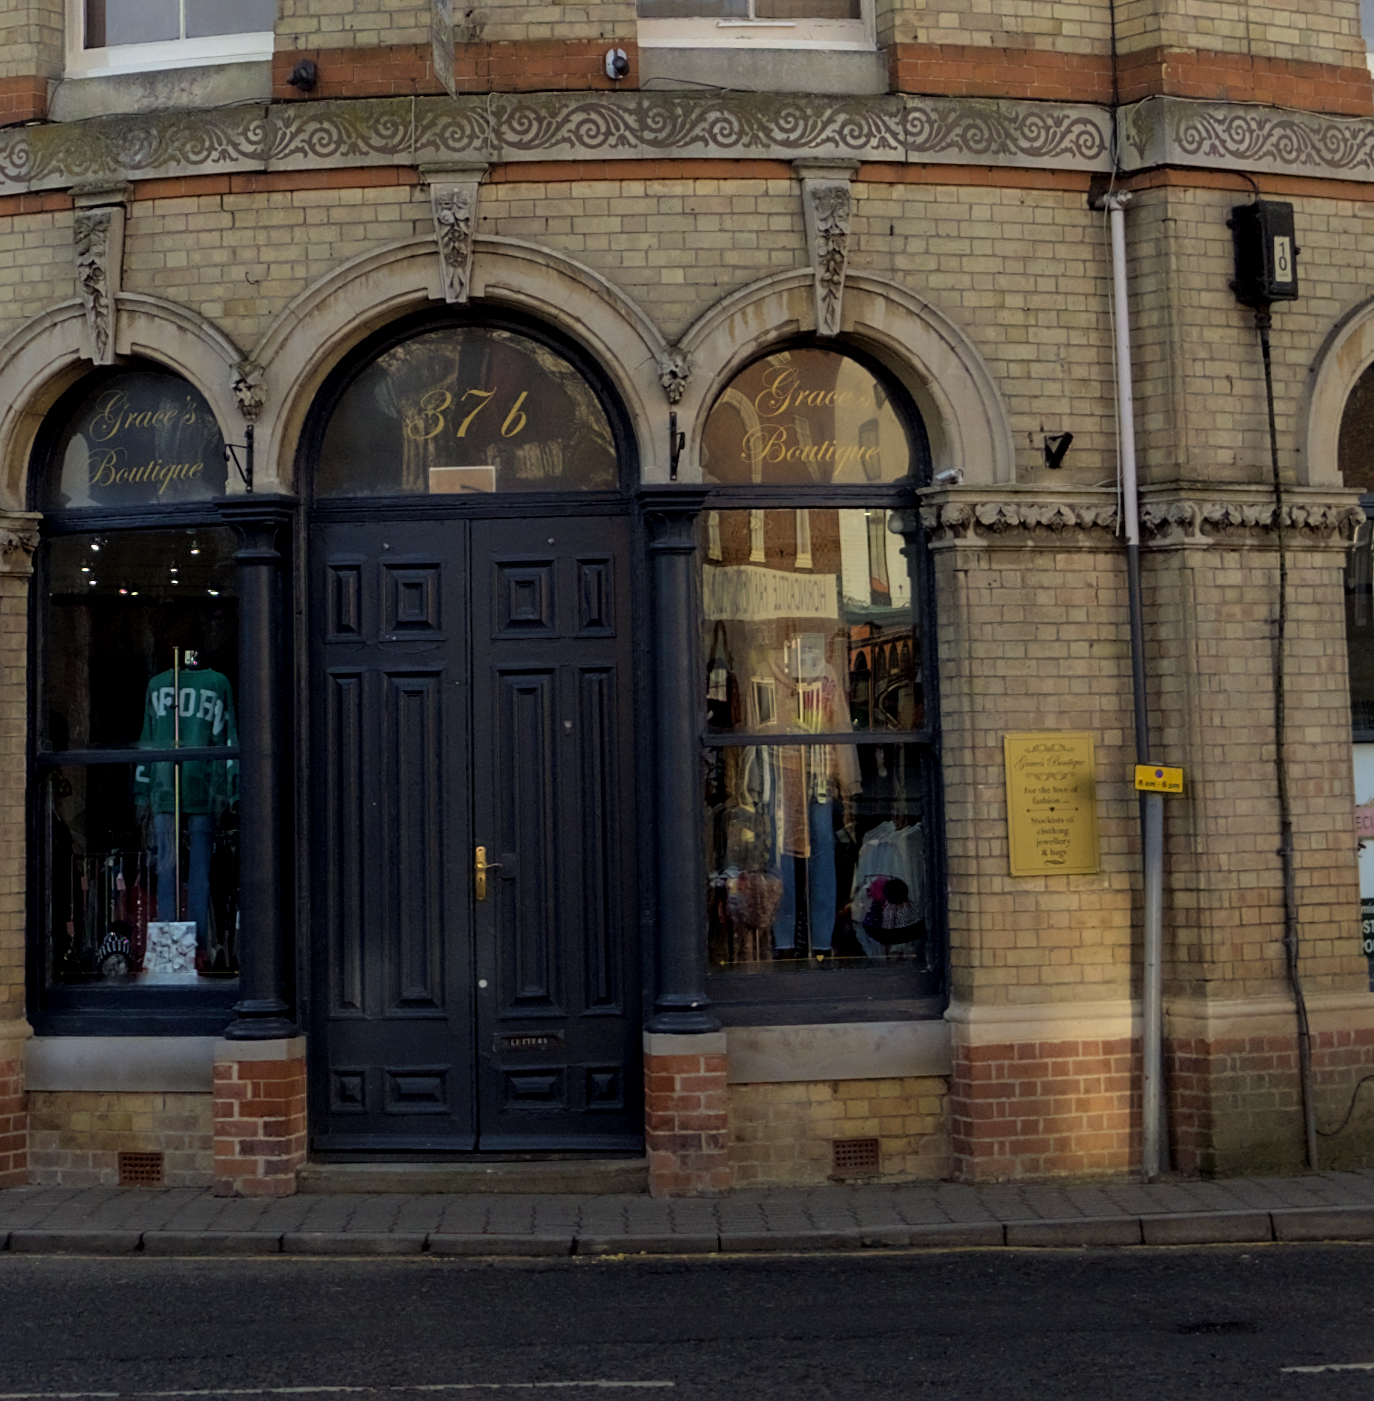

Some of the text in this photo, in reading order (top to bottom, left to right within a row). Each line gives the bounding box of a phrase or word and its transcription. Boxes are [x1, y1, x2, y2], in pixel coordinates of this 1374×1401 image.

[89, 389, 197, 442] Grace's
[79, 446, 204, 495] Boutique
[740, 423, 880, 476] Boutique
